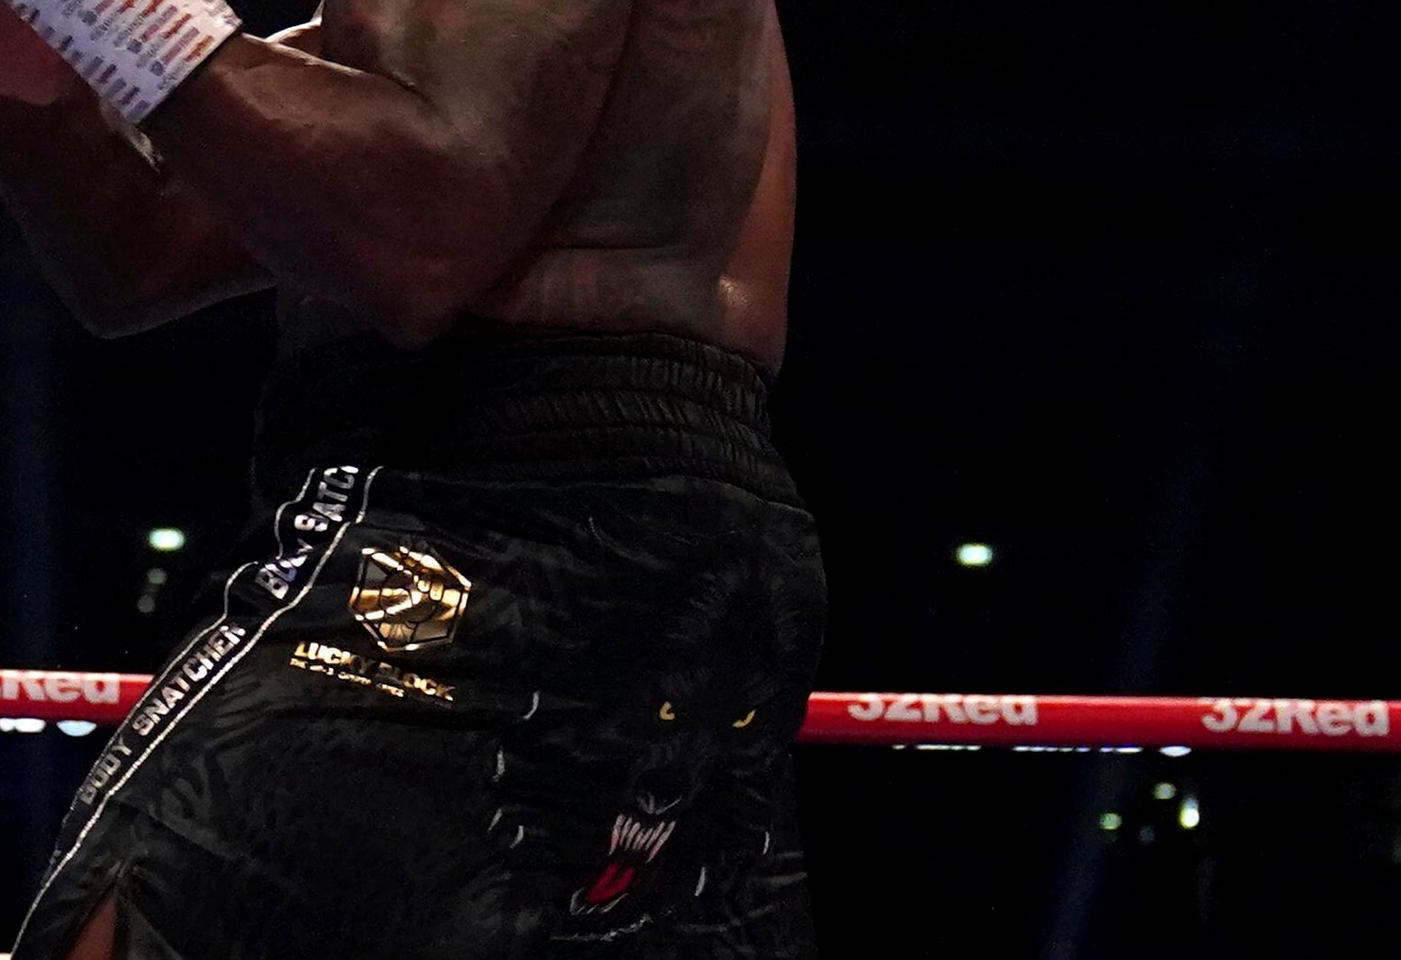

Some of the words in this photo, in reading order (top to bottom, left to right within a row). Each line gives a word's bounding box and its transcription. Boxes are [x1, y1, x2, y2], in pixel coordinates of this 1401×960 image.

[847, 692, 1038, 726] 32Red
[1200, 698, 1391, 738] 32Red
[80, 736, 133, 806] BODY
